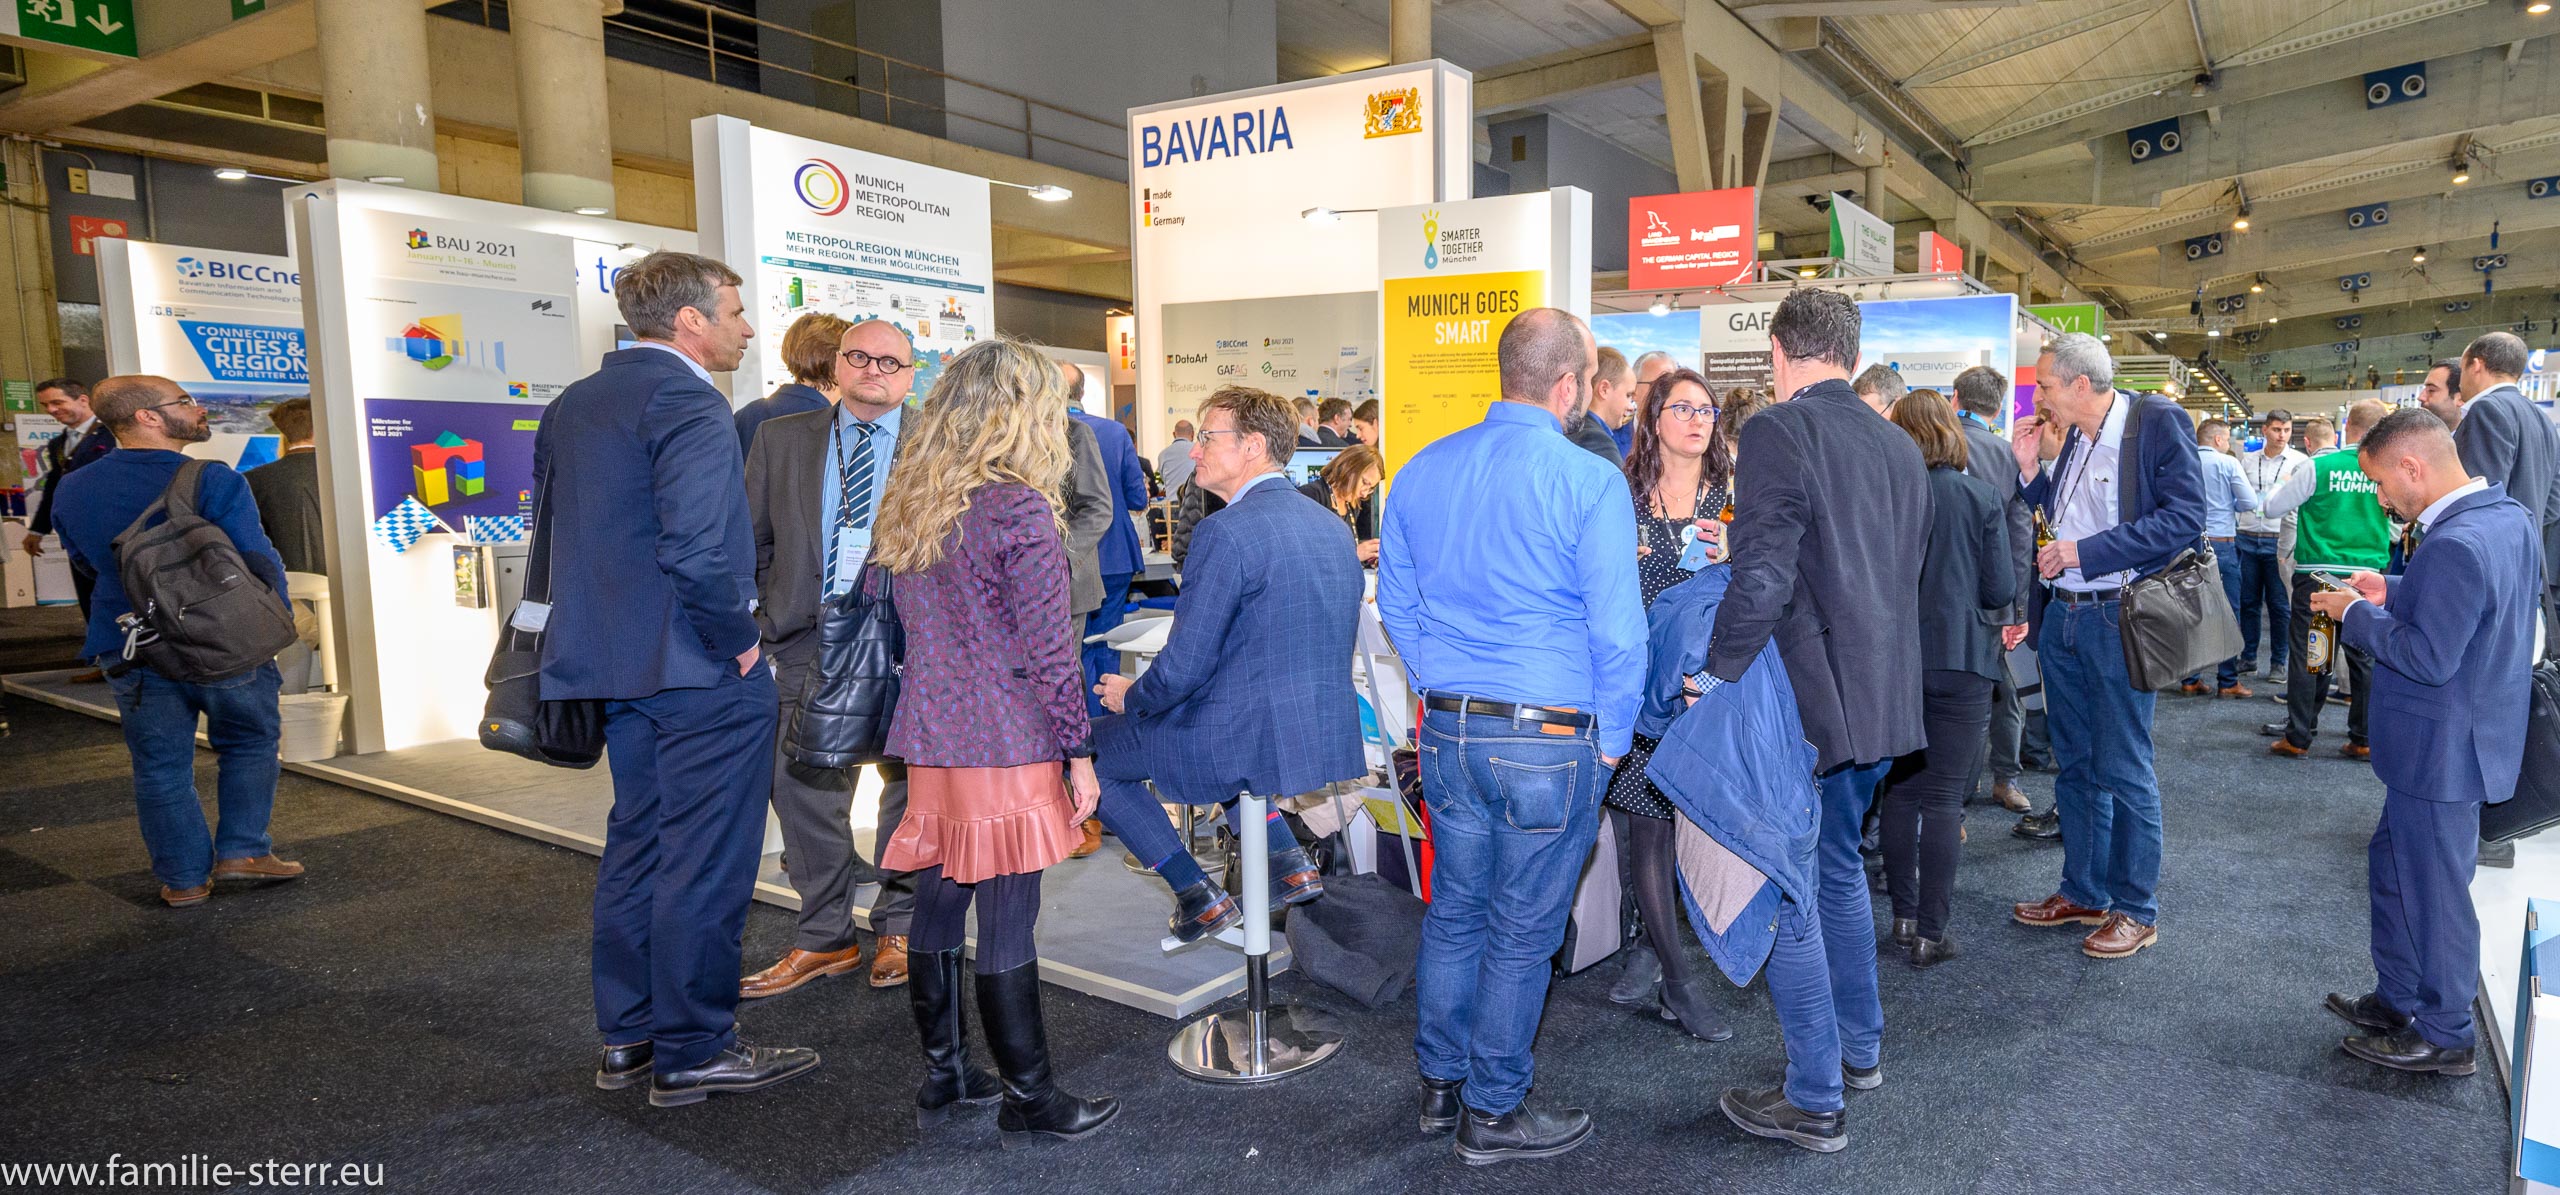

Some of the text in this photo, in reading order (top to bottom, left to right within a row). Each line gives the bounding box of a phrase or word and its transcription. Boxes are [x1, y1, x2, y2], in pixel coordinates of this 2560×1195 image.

[1142, 106, 1293, 168] BAVARIA
[855, 173, 904, 193] MUNICH
[1152, 189, 1172, 200] made
[856, 189, 950, 217] METROPOLITAN
[1153, 204, 1160, 213] in
[856, 205, 905, 223] REGION
[1153, 215, 1185, 226] Germany
[1441, 228, 1480, 242] SMARTER
[436, 235, 516, 258] BAU 2021
[786, 231, 959, 267] METROPOLREGION MÜNCHEN
[1442, 241, 1483, 255] TOGETHER
[407, 250, 444, 263] January
[483, 259, 517, 270] Munich
[786, 244, 815, 256] MEHR
[818, 249, 858, 262] REGION.
[861, 255, 888, 266] MEHR
[890, 258, 962, 277] MÖGLICHKEITEN.
[1442, 255, 1477, 264] München
[1641, 250, 1739, 264] THE GERMAN CAPITAL REGION
[208, 261, 301, 286] BICCne
[178, 279, 215, 288] Bavarian
[217, 283, 265, 292] Information
[179, 287, 244, 299] Communication
[247, 294, 291, 303] Technology
[1408, 289, 1519, 318] MUNICH GOES
[196, 326, 298, 342] CONNECTING
[1434, 319, 1490, 345] SMART
[205, 337, 306, 357] CITIES &
[1222, 340, 1248, 348] BICCnet
[214, 353, 309, 373] REGION
[1175, 353, 1208, 364] DataArt
[222, 369, 244, 378] FOR
[247, 371, 287, 380] BETTER
[1271, 368, 1297, 378] emz
[28, 431, 62, 440] ARE
[2329, 481, 2378, 494] HUMM
